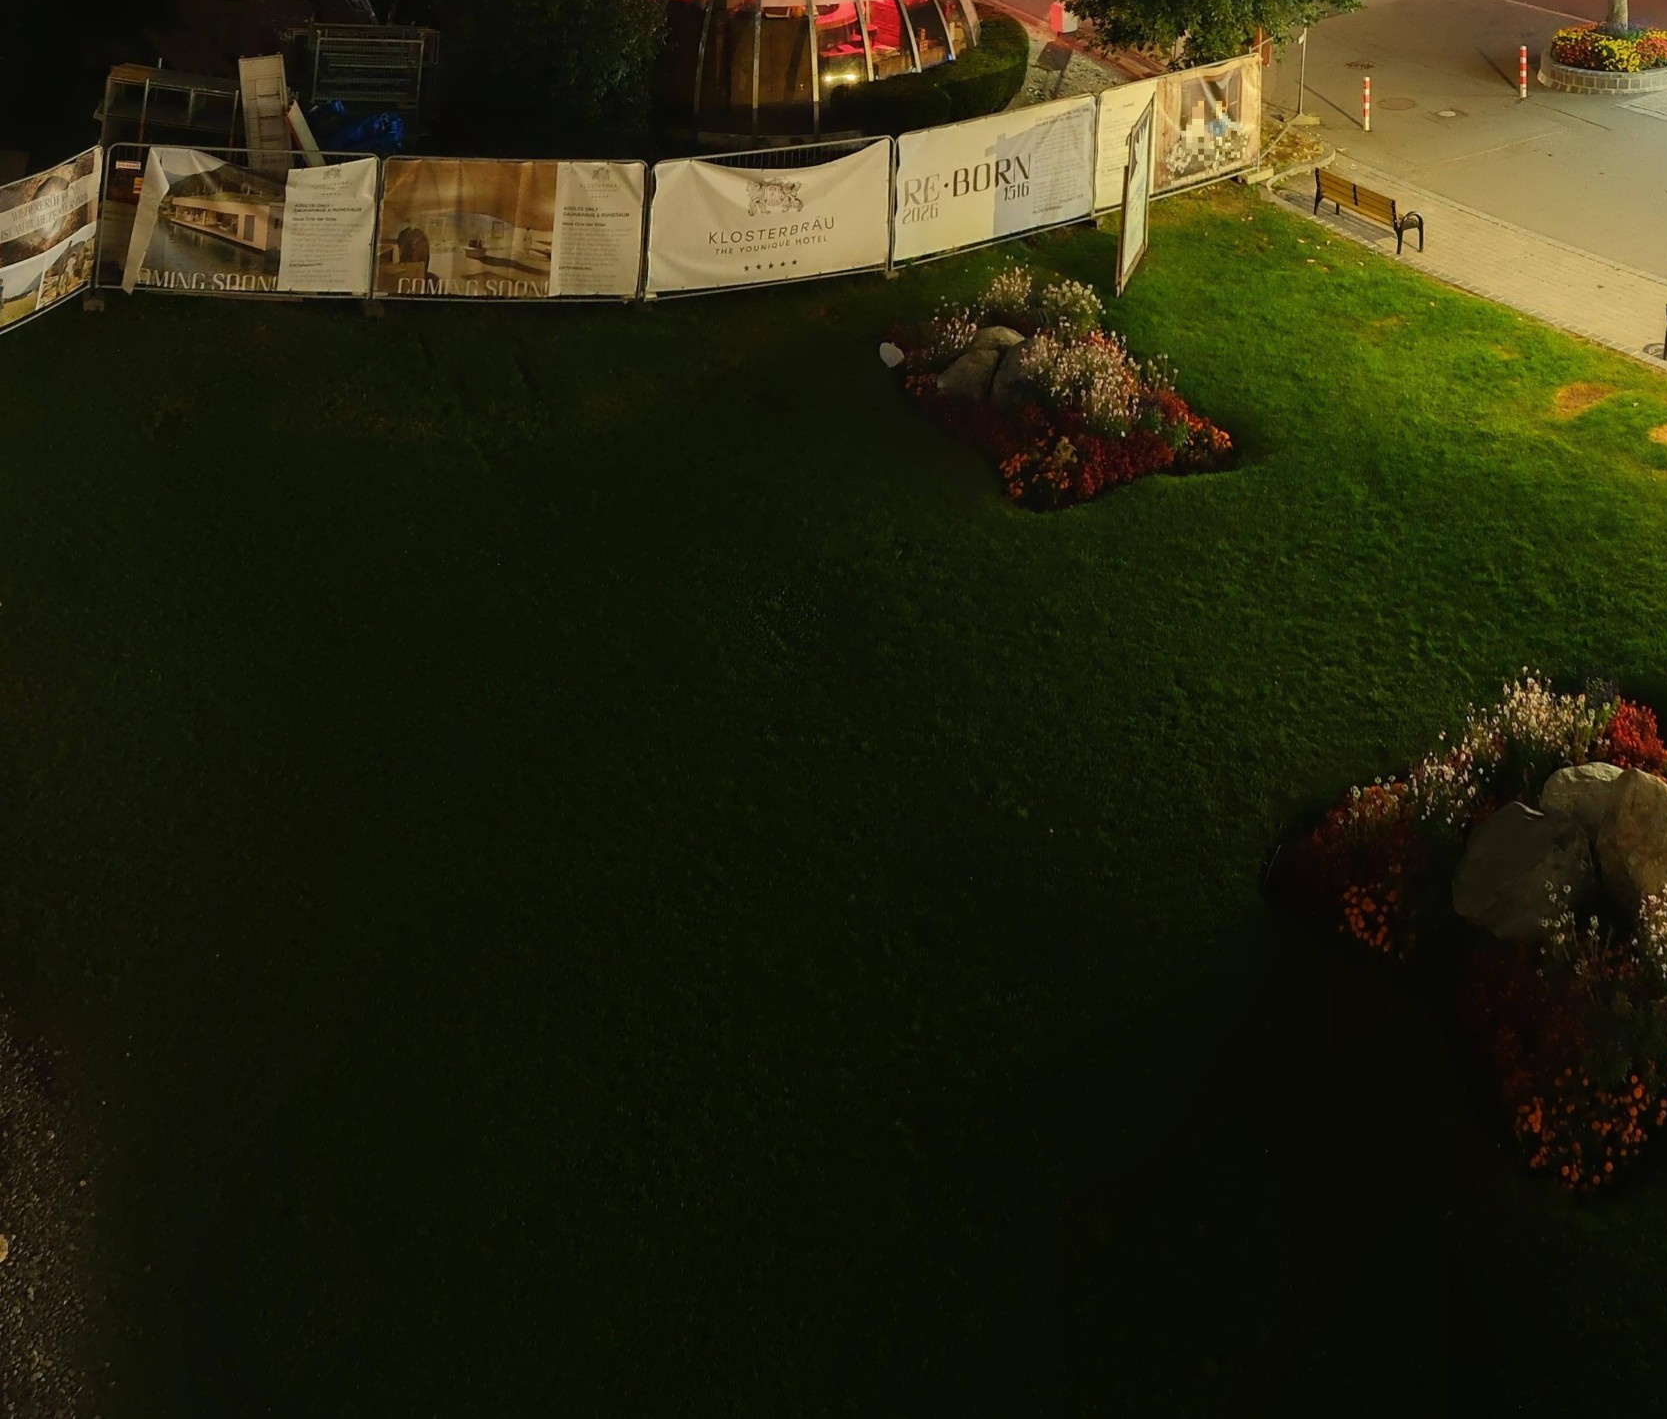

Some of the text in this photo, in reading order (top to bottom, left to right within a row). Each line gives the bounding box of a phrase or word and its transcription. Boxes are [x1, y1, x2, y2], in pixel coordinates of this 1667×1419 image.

[1004, 181, 1029, 201] 1516
[903, 203, 939, 224] 2026
[708, 215, 835, 245] KLOSTERBRÄU
[739, 239, 791, 254] YOUNIQUE
[795, 235, 828, 246] HOTEL
[137, 268, 207, 290] OMING
